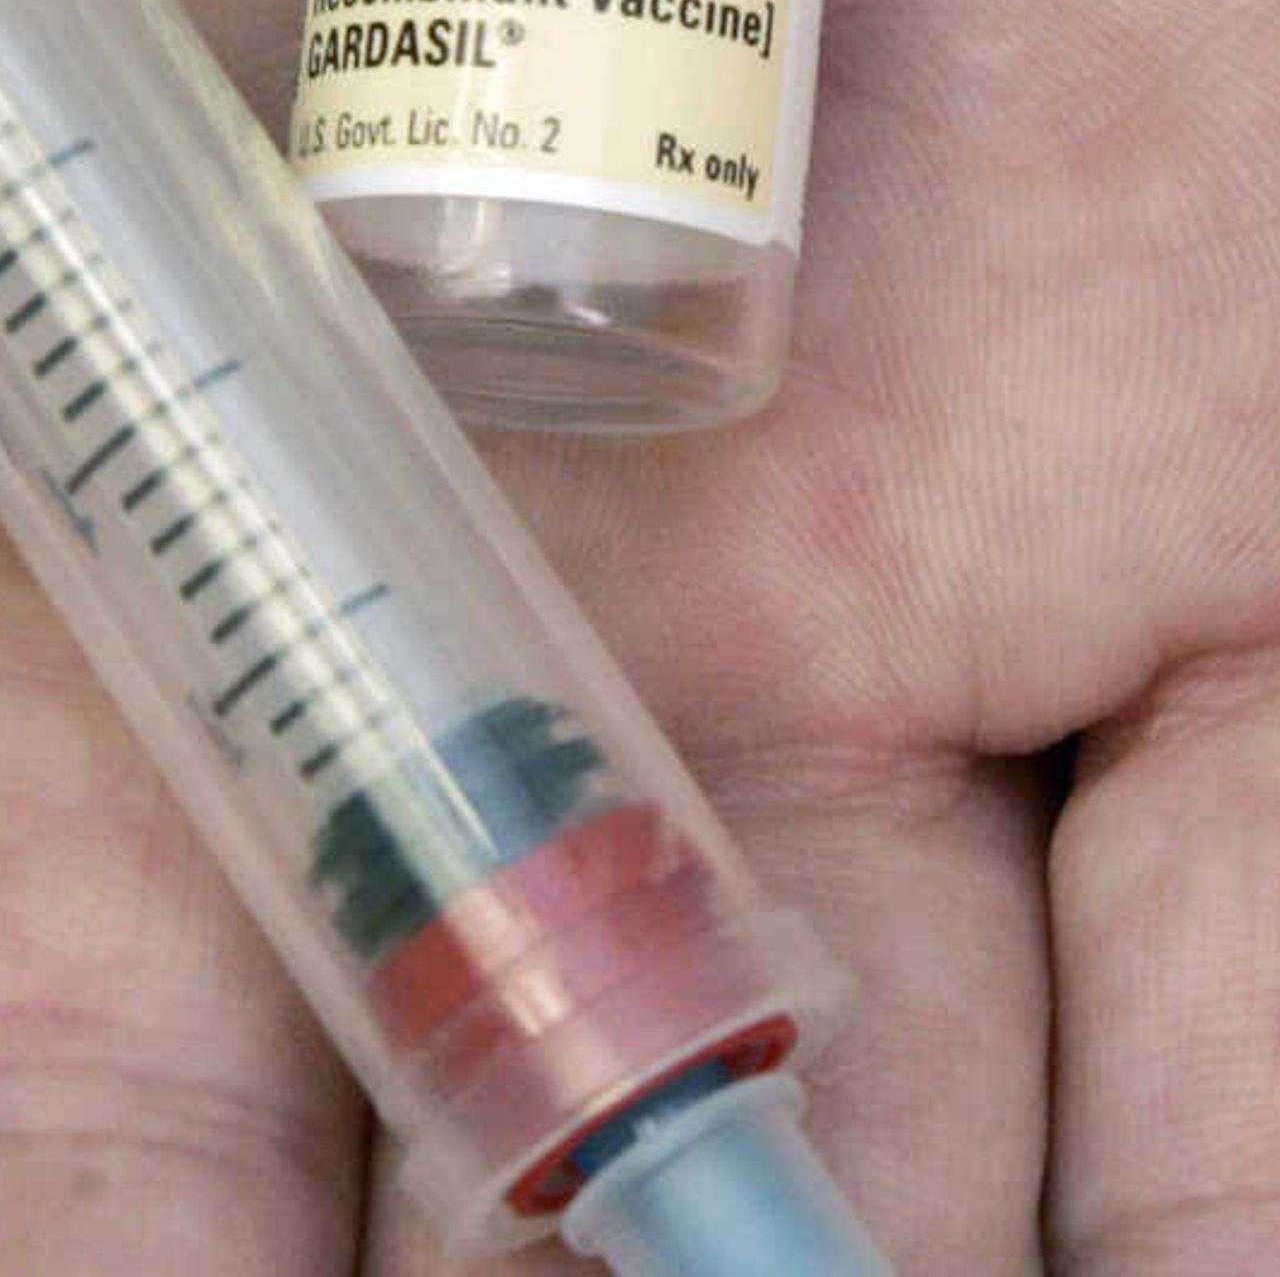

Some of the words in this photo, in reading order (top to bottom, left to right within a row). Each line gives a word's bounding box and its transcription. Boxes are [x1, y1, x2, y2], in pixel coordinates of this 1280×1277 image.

[540, 115, 561, 154] 2
[655, 133, 694, 175] Rx
[705, 155, 760, 200] only
